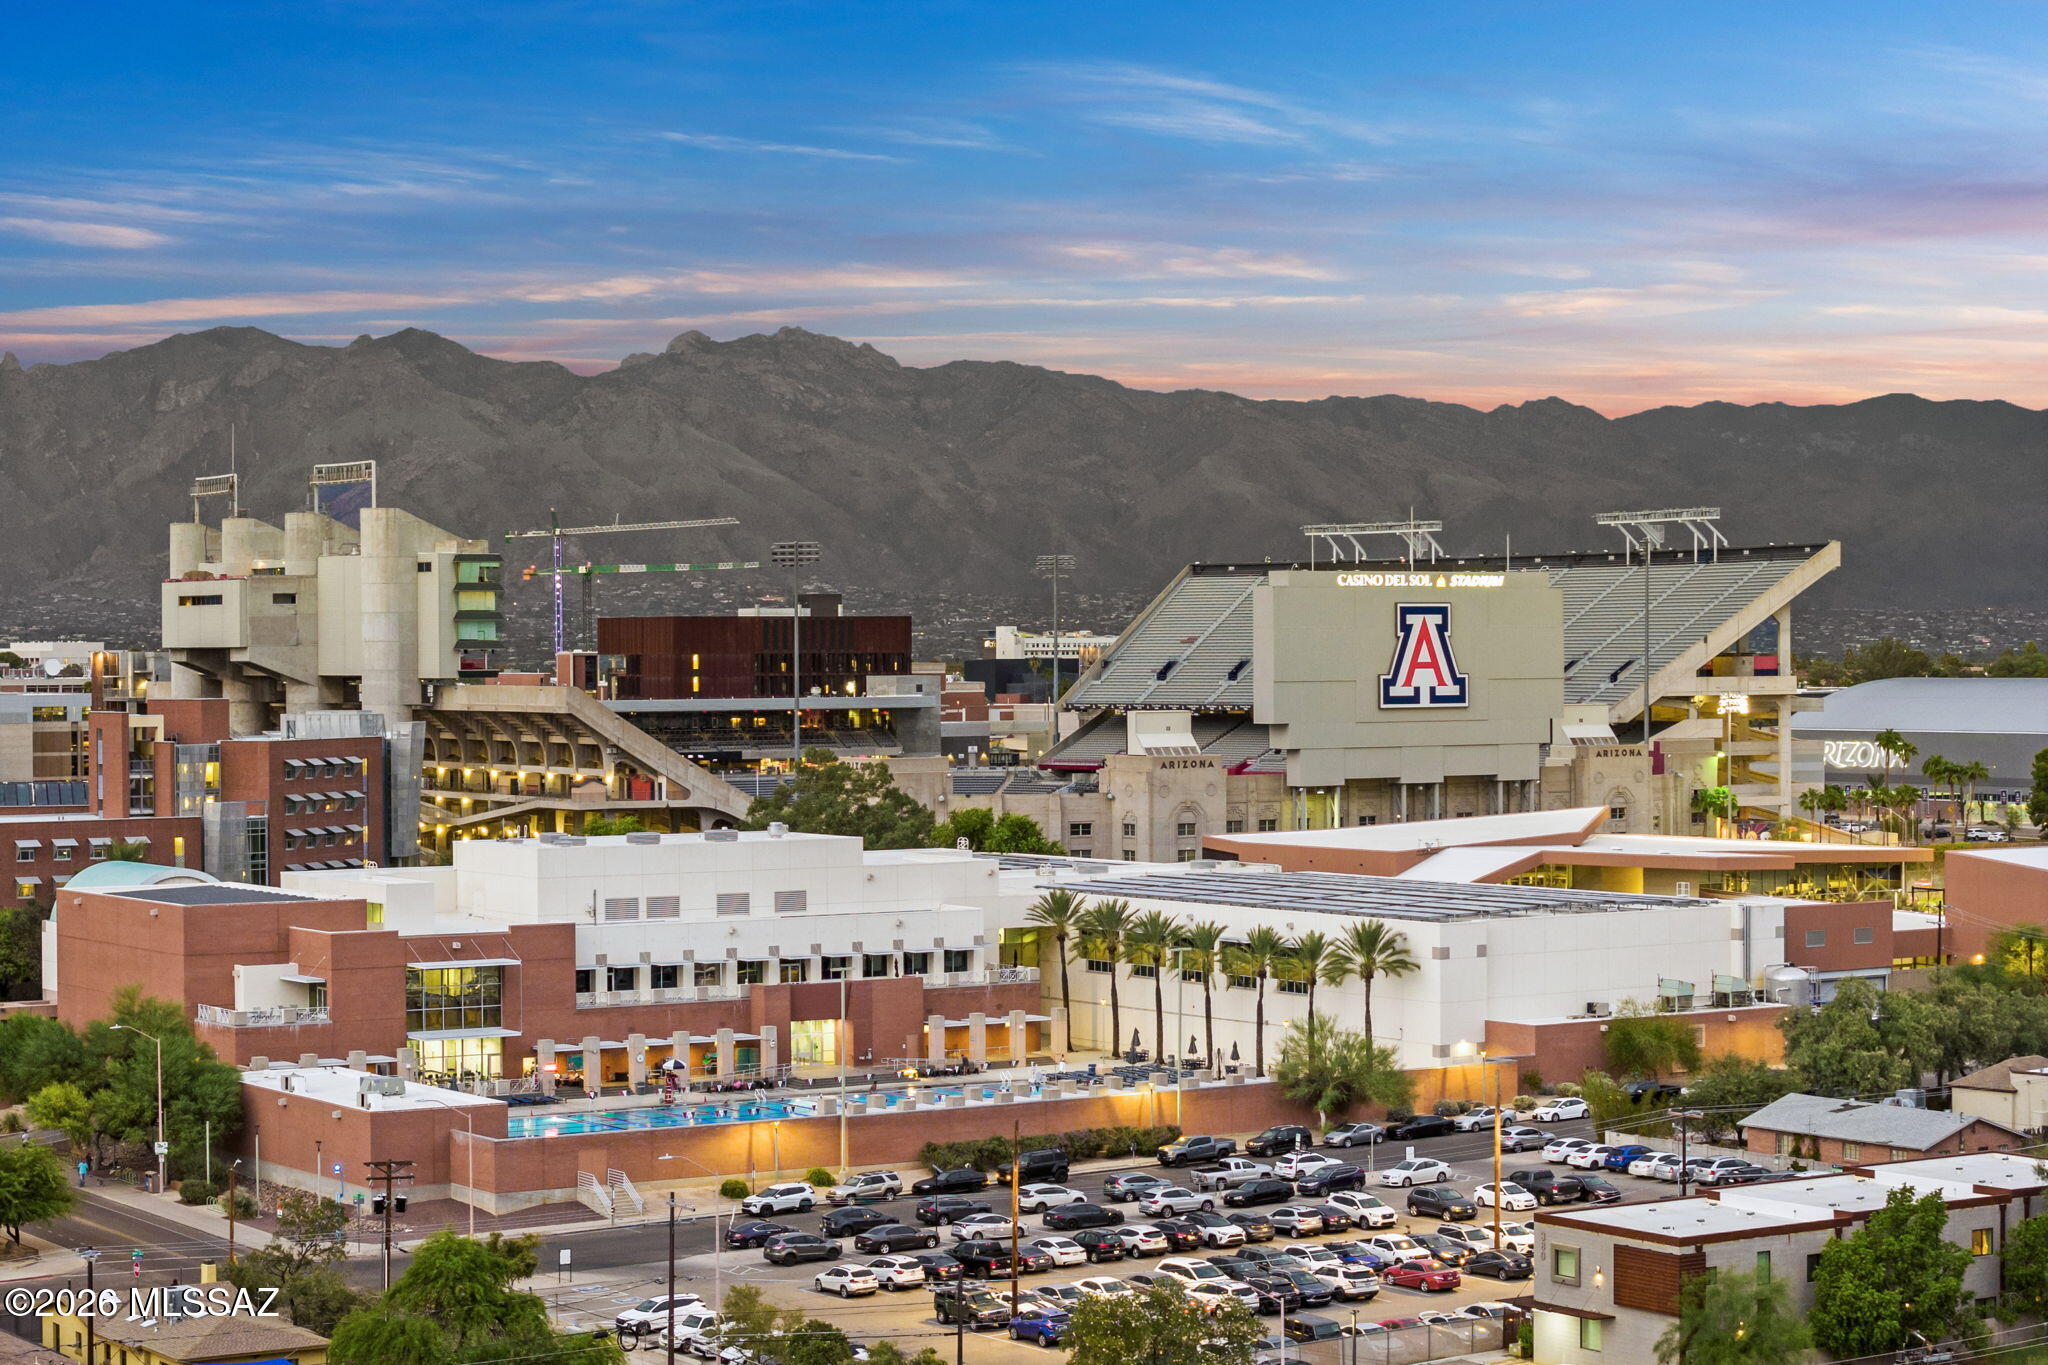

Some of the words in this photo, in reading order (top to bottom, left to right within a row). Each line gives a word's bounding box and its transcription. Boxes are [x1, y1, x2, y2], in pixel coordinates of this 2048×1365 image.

[1337, 574, 1383, 587] CASINO
[1385, 574, 1408, 587] DEL
[1409, 574, 1433, 587] SOL
[1450, 574, 1505, 587] STADIUM
[1380, 603, 1469, 709] A
[1596, 749, 1642, 757] ARIZONA
[1824, 741, 1908, 768] RIZONA
[1160, 760, 1215, 769] ARIZONA
